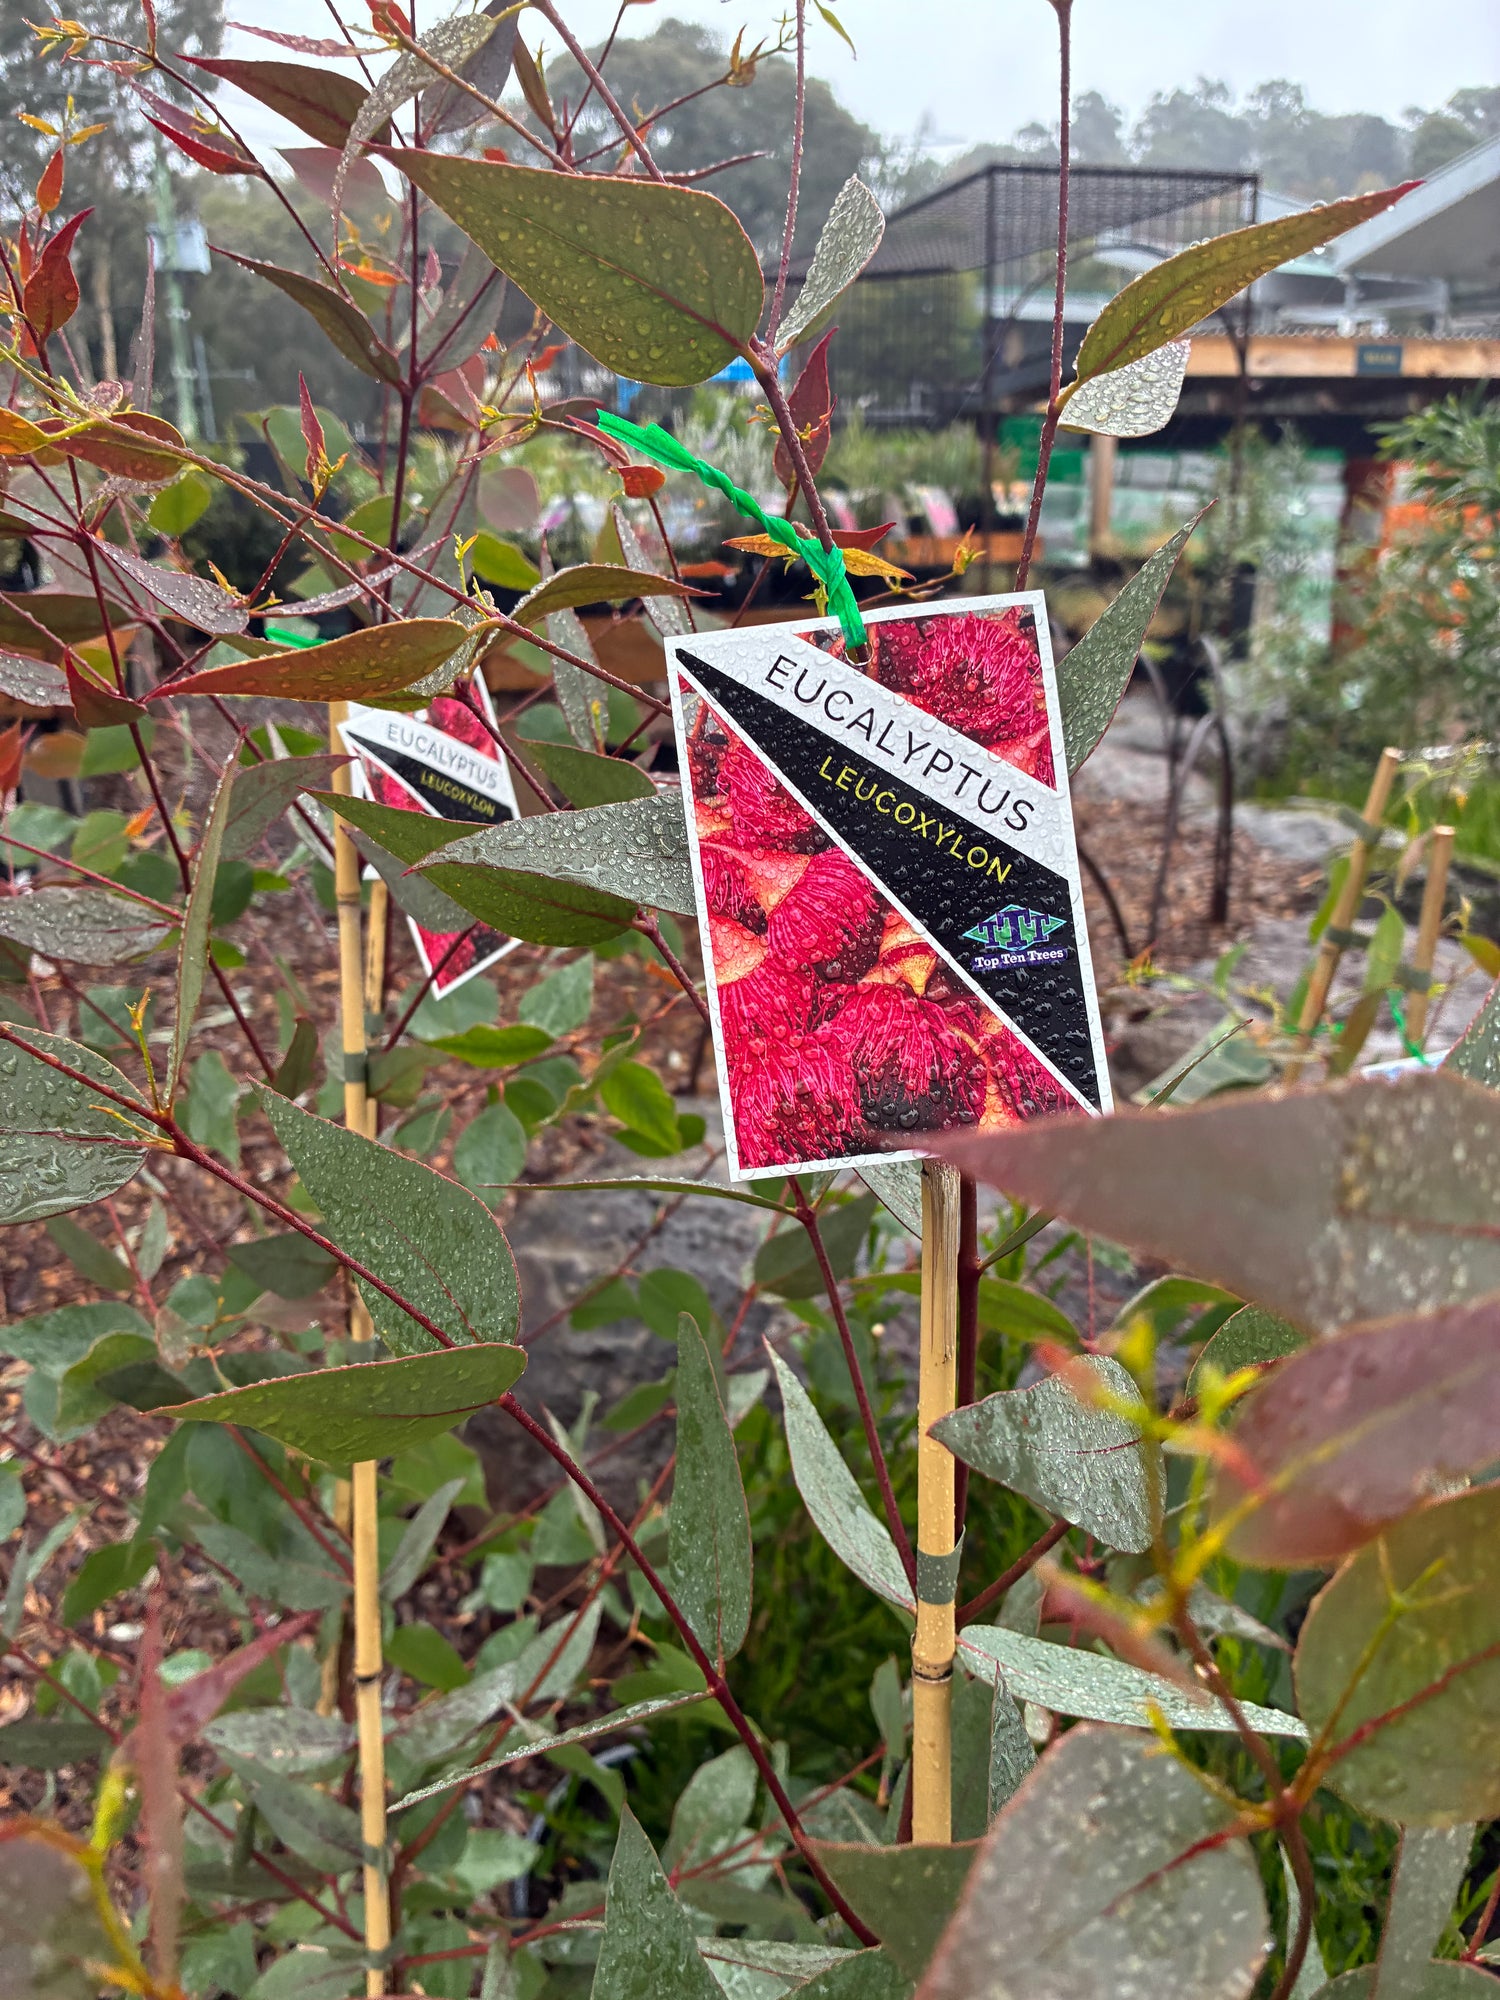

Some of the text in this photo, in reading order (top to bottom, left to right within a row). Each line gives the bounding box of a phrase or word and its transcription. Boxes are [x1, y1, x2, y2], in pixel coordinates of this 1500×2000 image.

[387, 723, 498, 790] EUCALYPTUS
[764, 654, 1035, 831] EUCALYPTUS
[420, 770, 496, 817] LEUCOXYLON
[818, 755, 1012, 884] LEUCOXYLON
[977, 909, 1050, 948] TTT
[974, 949, 1064, 969] Top Ten Trees
